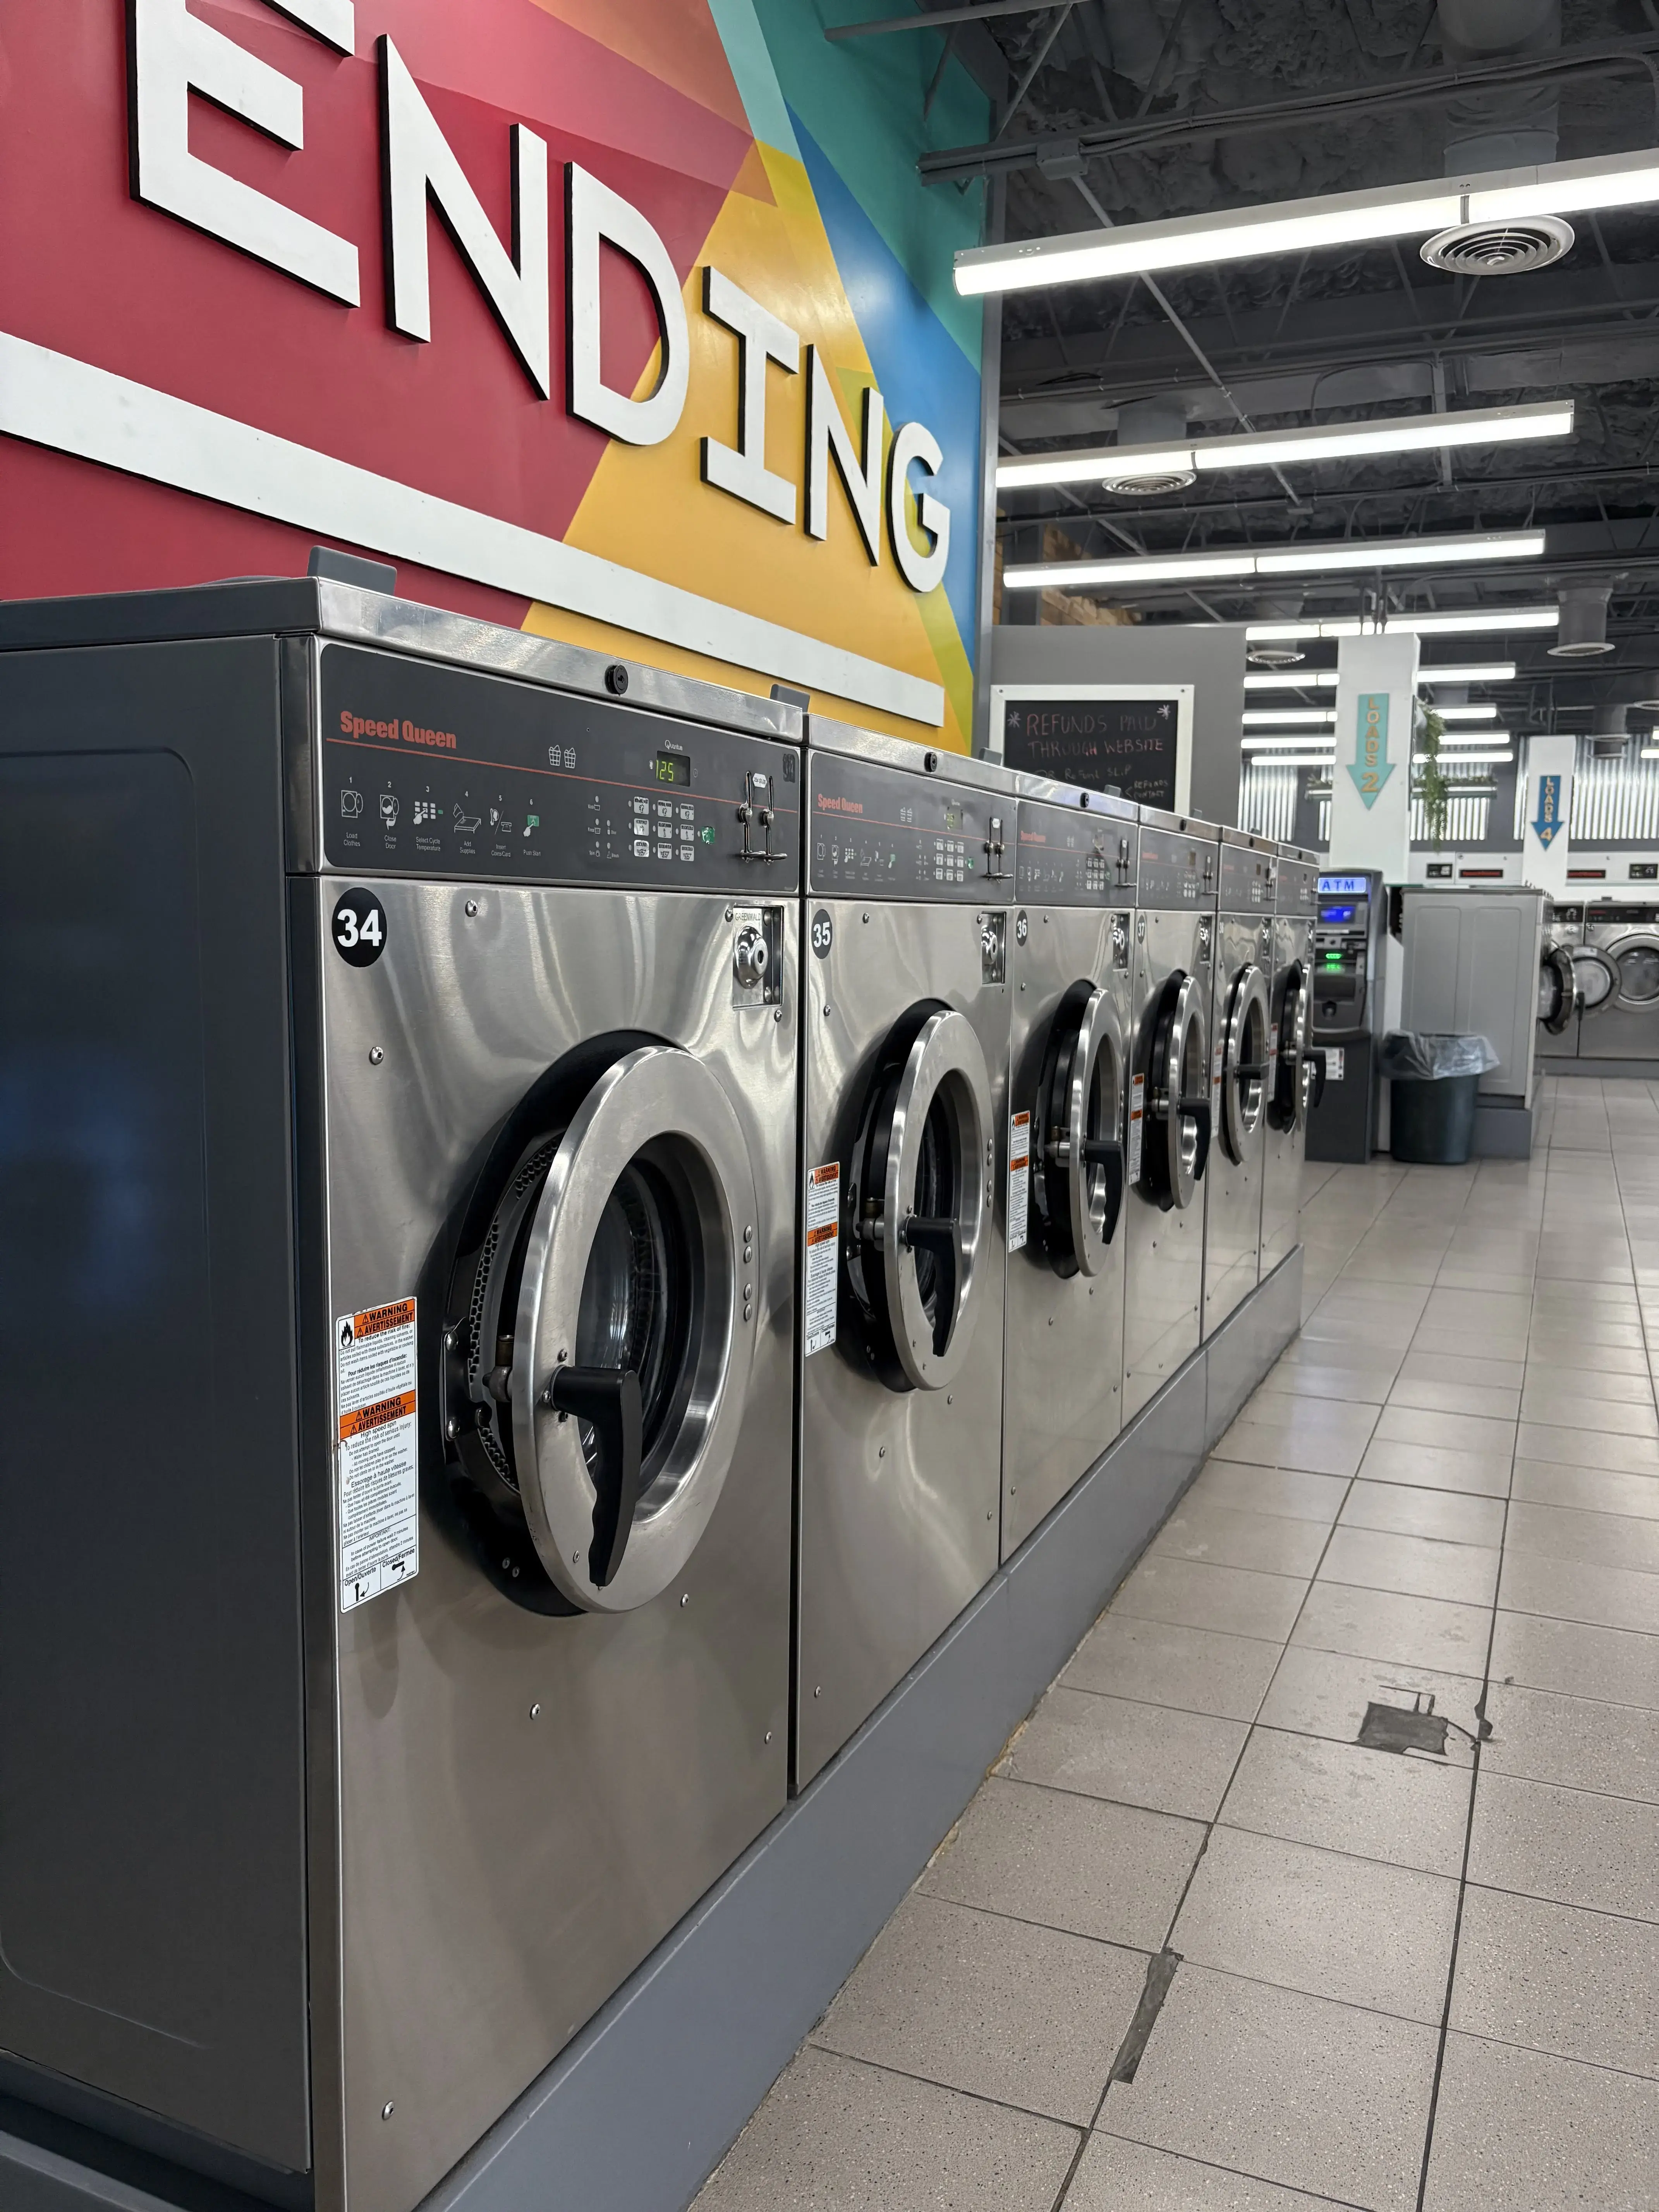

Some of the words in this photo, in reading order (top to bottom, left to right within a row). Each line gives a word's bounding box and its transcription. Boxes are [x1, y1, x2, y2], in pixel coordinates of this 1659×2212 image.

[341, 711, 398, 739] Speed
[402, 721, 456, 749] Queen
[1027, 714, 1107, 736] REFUNDS
[1120, 715, 1156, 732] PAID
[1365, 697, 1380, 767] LOADS
[1028, 740, 1097, 759] THROUGH
[1104, 738, 1164, 754] WEBSITE
[1362, 774, 1379, 793] 2
[818, 793, 840, 811] Speed
[842, 797, 862, 813] Queen
[1544, 776, 1554, 823] LOADS
[1540, 827, 1552, 841] 4
[1322, 881, 1354, 891] ATM
[735, 913, 761, 921] GREENWALD
[337, 909, 382, 947] 34
[813, 922, 831, 948] 35
[1017, 919, 1027, 938] 36
[1138, 927, 1144, 937] 37
[369, 1302, 407, 1322] WARNING
[364, 1312, 413, 1334] AVERTISSEMENT
[364, 1332, 379, 1342] reduce
[388, 1327, 396, 1335] risk
[358, 1405, 406, 1431] AVERTISSEMENT
[362, 1396, 401, 1419] WARNING
[350, 1437, 364, 1448] reduce
[385, 1425, 399, 1436] serious
[361, 1429, 371, 1439] High
[372, 1423, 386, 1435] speed
[386, 1420, 396, 1429] spin
[351, 1474, 373, 1489] Essorage
[377, 1467, 390, 1477] haute
[391, 1460, 406, 1472] vitesse
[382, 1547, 414, 1568] Closed/Fermée
[344, 1565, 376, 1588] Open/Ouverte
